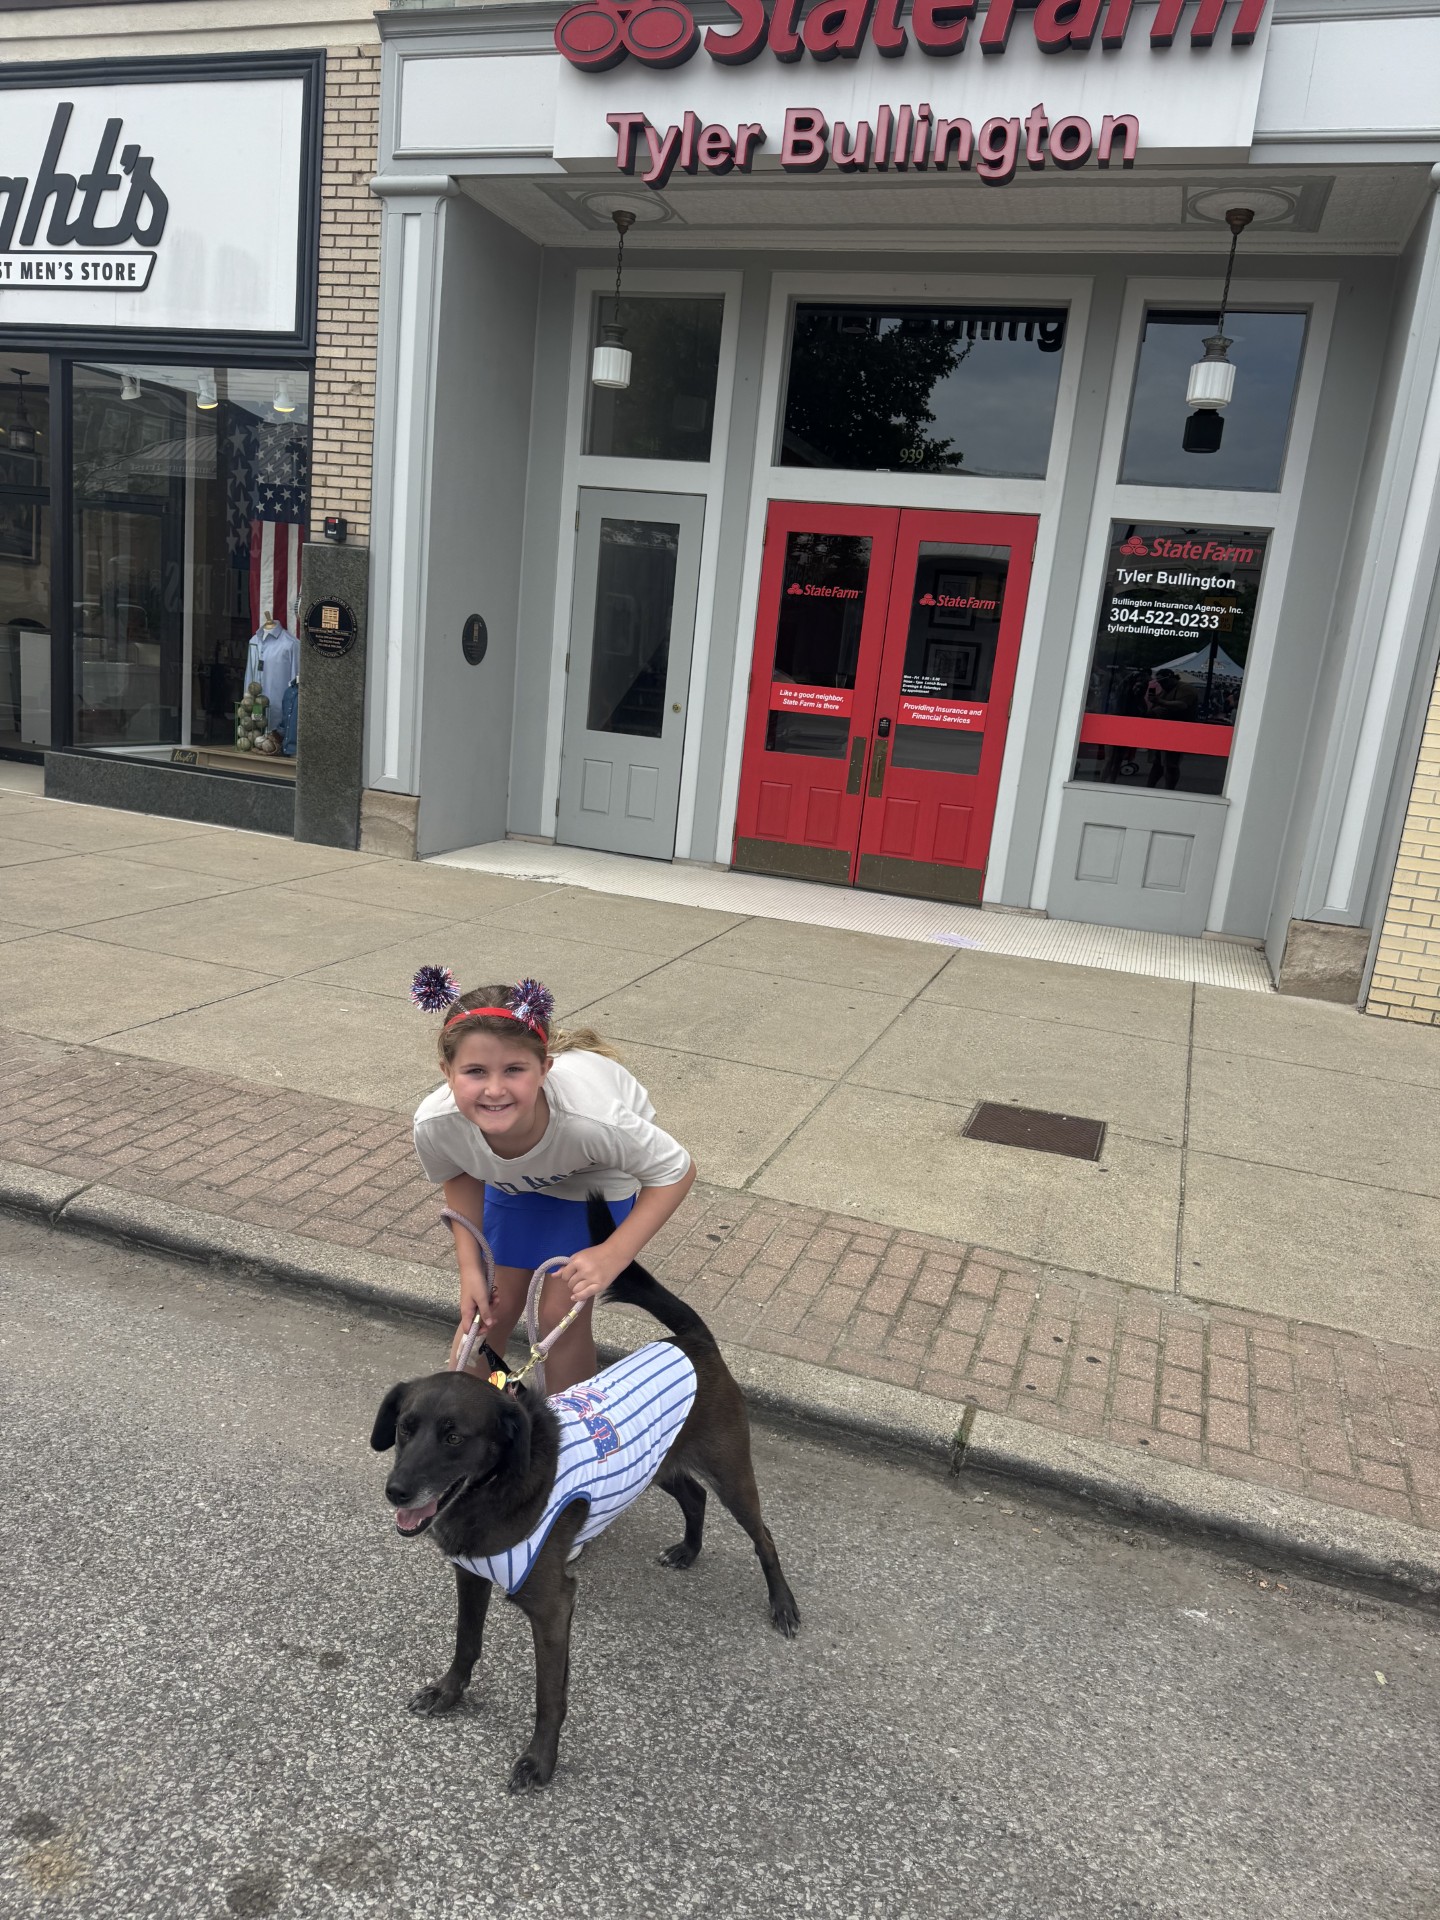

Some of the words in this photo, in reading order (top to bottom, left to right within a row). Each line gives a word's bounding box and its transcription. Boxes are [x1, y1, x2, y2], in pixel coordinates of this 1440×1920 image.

[607, 111, 764, 187] Tyler
[781, 103, 1139, 185] Bullington
[20, 262, 73, 280] MEN'S
[81, 262, 136, 281] STORE
[899, 448, 924, 463] 939
[1116, 568, 1153, 584] Tyler
[1156, 571, 1236, 590] Bullington
[1112, 597, 1153, 608] Bullington
[1154, 600, 1194, 611] Insurance
[1194, 603, 1227, 615] Agency,
[1228, 606, 1244, 615] Inc.
[1110, 607, 1220, 629] 304-522-0233
[1107, 623, 1200, 638] tylerbullington.com
[779, 689, 792, 697] Like
[799, 692, 815, 700] good
[816, 692, 844, 703] neighbor,
[782, 698, 799, 706] State
[799, 700, 815, 708] Farm
[823, 702, 839, 710] there
[903, 702, 934, 713] Providing
[935, 705, 968, 716] Insurance
[911, 712, 942, 722] Financial
[942, 714, 971, 724] Services
